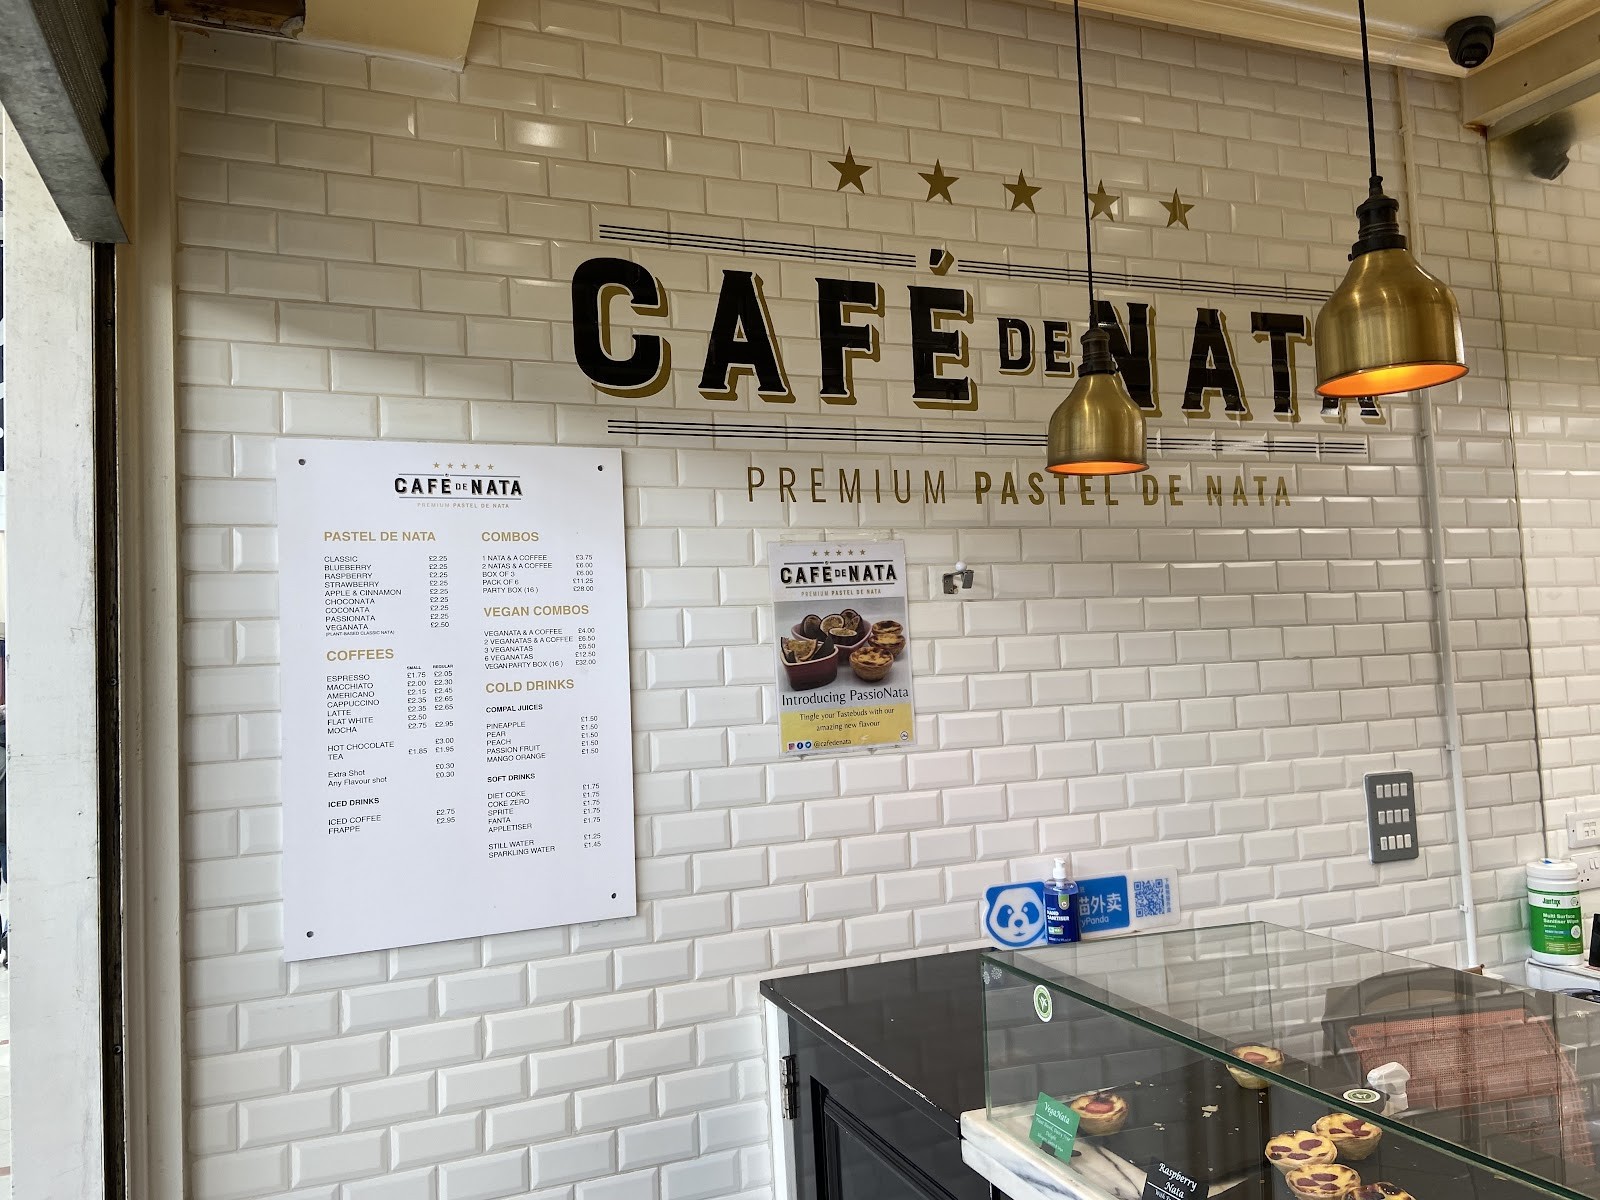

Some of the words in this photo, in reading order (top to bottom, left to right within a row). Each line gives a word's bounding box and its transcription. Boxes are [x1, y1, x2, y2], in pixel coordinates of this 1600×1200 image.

[571, 248, 979, 411] CAFÉ
[997, 317, 1075, 378] DE
[1093, 300, 1387, 425] NAT
[471, 479, 523, 495] NATA
[747, 466, 946, 503] PREMIUM
[974, 471, 1119, 506] PASTEL
[1143, 475, 1184, 506] DE
[1206, 475, 1291, 507] NATA
[324, 532, 376, 541] PASTEL
[380, 532, 398, 541] DE
[402, 532, 436, 541] NATA
[482, 532, 539, 542] COMBOS
[781, 561, 832, 584] CAFÉ
[835, 569, 847, 578] DE
[849, 565, 897, 582] NATA
[484, 607, 529, 617] VEGAN
[534, 605, 589, 616] COMBOS
[326, 649, 394, 661] COFFEES
[327, 674, 370, 682] ESPRESSO
[486, 682, 522, 693] COLD
[526, 679, 574, 691] DRINKS
[327, 691, 374, 699] AMERICANO
[782, 692, 846, 706] Introducing
[850, 688, 909, 701] PassioNata
[327, 700, 380, 708] CAPPUCCINO
[800, 712, 820, 721] Tingle
[822, 712, 835, 721] your
[837, 710, 867, 718] Tastebuds
[816, 723, 843, 732] amazing
[347, 741, 394, 750] CHOCOLATE
[814, 739, 851, 748] @cafedenata
[487, 746, 517, 754] PASSION
[350, 798, 380, 806] DRINKS
[488, 800, 508, 808] COKE
[488, 808, 514, 816] SPRITE
[328, 818, 347, 826] ICED
[350, 815, 382, 824] COFFEE
[328, 826, 360, 834] FRAPPE
[488, 823, 532, 833] APPLETISER
[489, 842, 508, 850] STILL
[489, 849, 529, 858] SPARKLING
[530, 846, 555, 854] WATER
[1081, 916, 1109, 928] yPanda
[1044, 1102, 1070, 1124] VegaNata
[1158, 1163, 1197, 1192] Raspberry
[1164, 1182, 1184, 1198] Nata
